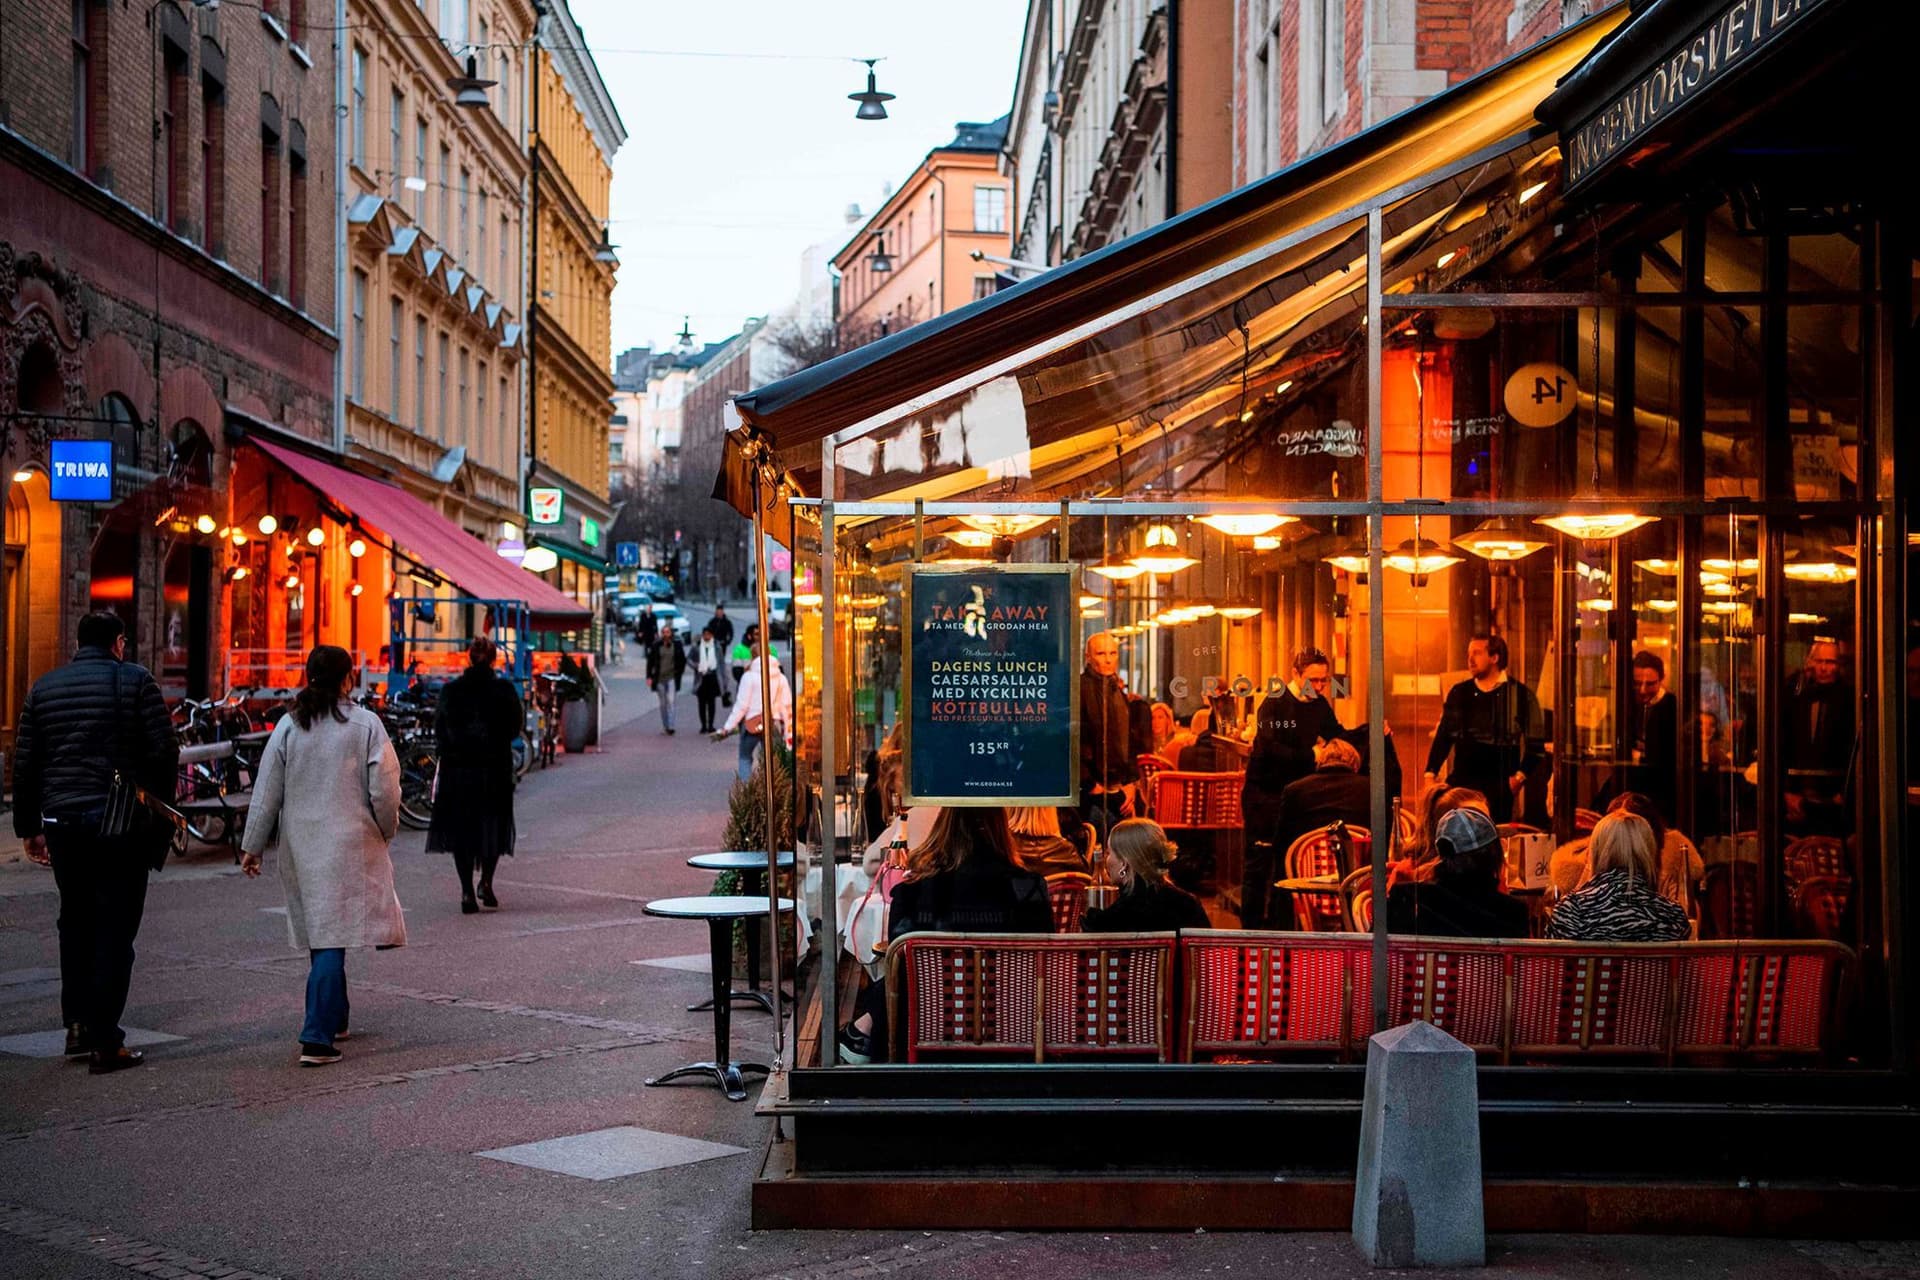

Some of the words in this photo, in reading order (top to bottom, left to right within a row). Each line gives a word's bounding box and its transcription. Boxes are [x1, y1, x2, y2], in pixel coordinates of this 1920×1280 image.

[55, 462, 108, 478] TRIWA
[932, 605, 970, 620] TAK
[991, 605, 1049, 621] AWAY
[932, 622, 942, 630] TA
[944, 622, 964, 630] MED
[986, 622, 1026, 631] GRODAN
[1028, 622, 1049, 631] HEM
[931, 661, 991, 672] DAGENS
[997, 661, 1048, 672] LUNCH
[931, 674, 1048, 686] CAESARSALLAD
[932, 687, 965, 699] MED
[971, 687, 1047, 699] KYCKLING
[1169, 675, 1350, 699] GRODAN
[931, 699, 1048, 715] KÖTTBULLAR
[1269, 719, 1297, 729] 1985
